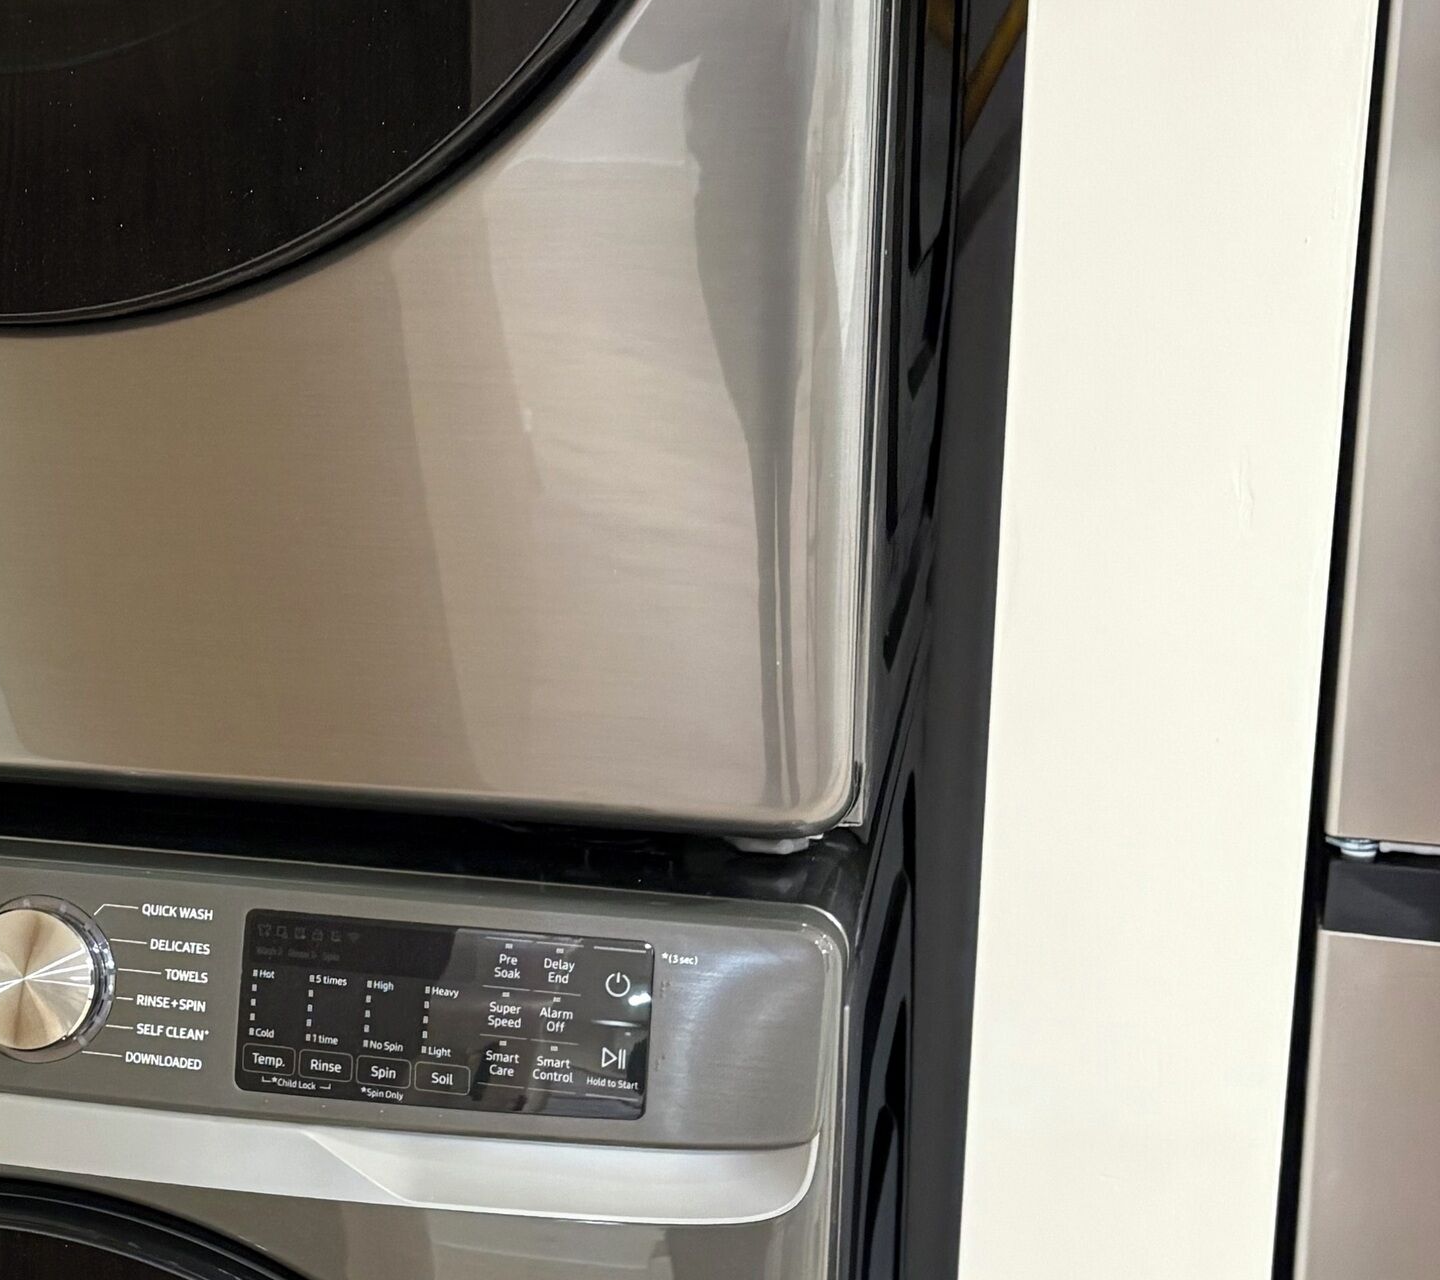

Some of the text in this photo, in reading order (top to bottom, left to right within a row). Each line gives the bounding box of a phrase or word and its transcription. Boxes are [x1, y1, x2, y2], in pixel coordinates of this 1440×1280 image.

[142, 903, 214, 921] QUICK WASH
[150, 938, 211, 955] DELICATES
[498, 953, 518, 966] Pre
[543, 957, 575, 973] Delay
[165, 968, 209, 984] TOWELS
[259, 969, 275, 979] Hot
[493, 966, 521, 979] Soak
[547, 971, 570, 984] End
[315, 974, 348, 987] 5 times
[373, 980, 395, 993] High
[431, 986, 460, 999] Heavy
[489, 1001, 522, 1015] Super
[539, 1006, 574, 1020] Alarm
[487, 1015, 522, 1029] Speed
[546, 1021, 566, 1033] Off
[136, 1023, 164, 1037] SELF
[255, 1027, 275, 1039] Cold
[312, 1033, 339, 1046] 1 time
[369, 1040, 404, 1053] No Spin
[428, 1046, 452, 1059] Light
[125, 1051, 203, 1071] DOWNLOADED
[252, 1052, 286, 1068] Temp.
[485, 1050, 521, 1064] Smart
[536, 1056, 571, 1069] Smart
[310, 1058, 343, 1073] Rinse
[489, 1064, 515, 1077] Care
[370, 1065, 397, 1080] Spin
[431, 1072, 454, 1086] Soil
[532, 1069, 574, 1084] Control
[298, 1080, 317, 1090] Lock
[586, 1076, 639, 1090] Hold to Start
[385, 1089, 404, 1102] Only
